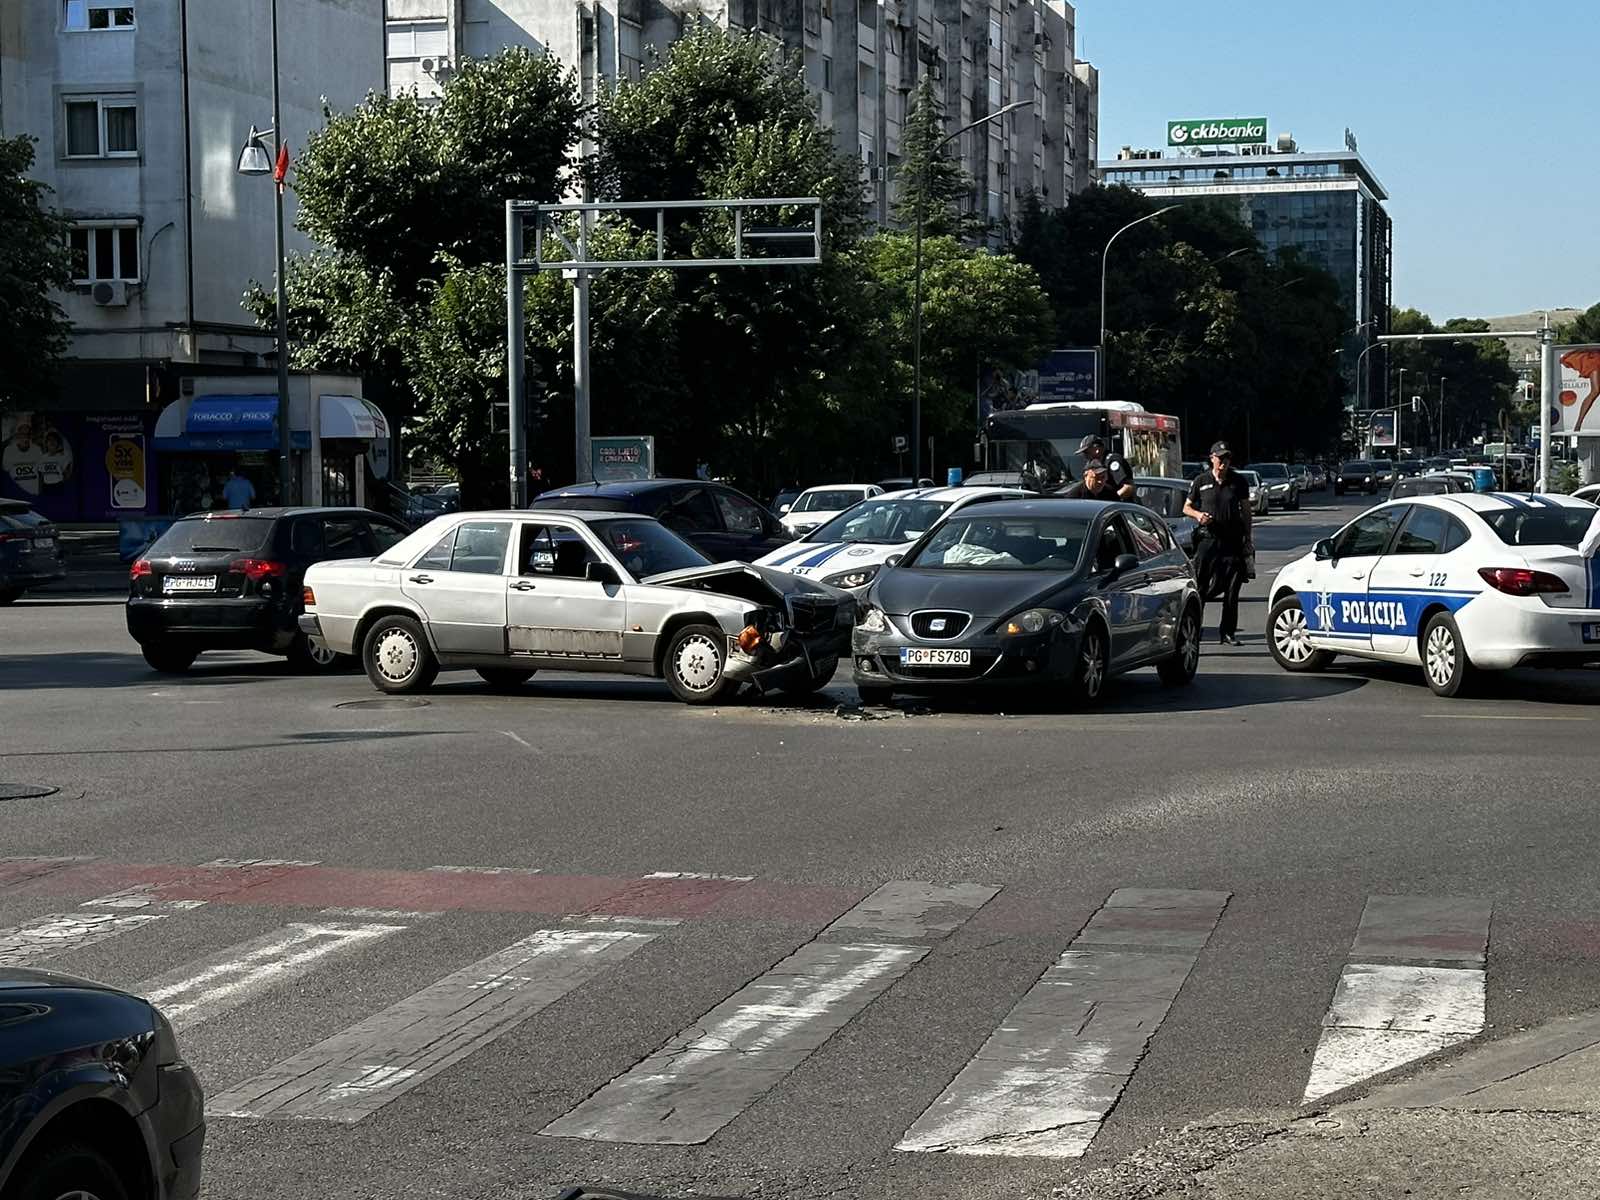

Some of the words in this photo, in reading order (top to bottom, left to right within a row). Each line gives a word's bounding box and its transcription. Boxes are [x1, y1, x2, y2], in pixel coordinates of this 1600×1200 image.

[1190, 121, 1264, 139] ckbbanka
[1429, 573, 1448, 586] 122
[1341, 600, 1407, 630] POLICIJA
[908, 650, 922, 662] PG
[929, 650, 969, 663] FS780
